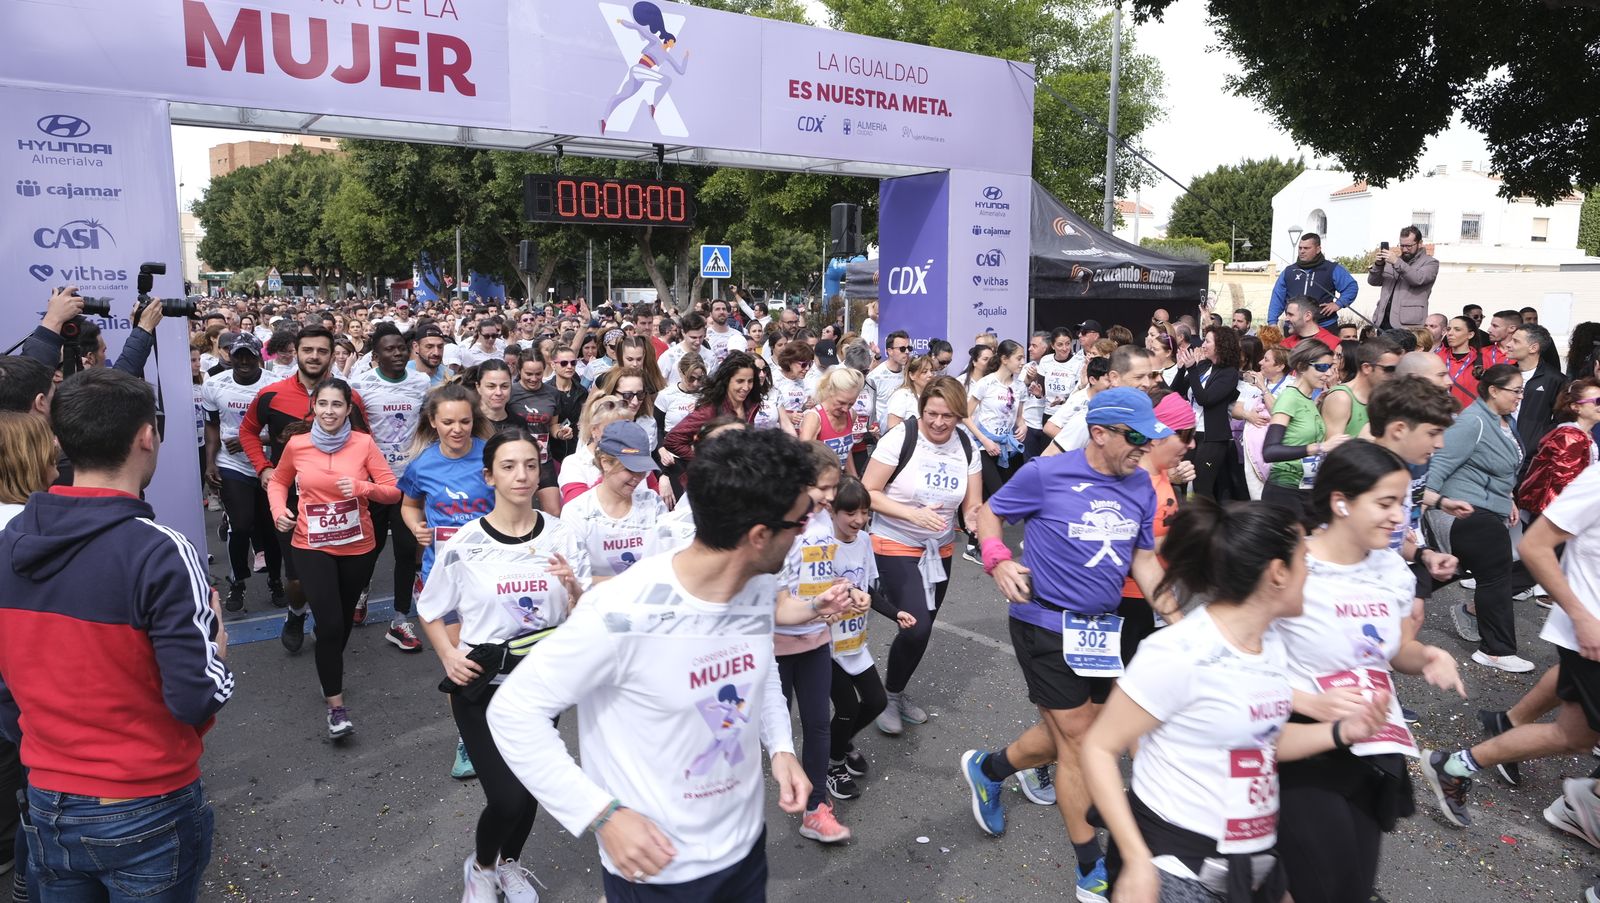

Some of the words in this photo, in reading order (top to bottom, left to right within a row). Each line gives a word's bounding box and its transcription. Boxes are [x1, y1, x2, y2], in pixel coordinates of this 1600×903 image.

[183, 0, 476, 96] MUJER
[818, 51, 839, 72] LA
[844, 55, 929, 85] IGUALDAD
[789, 79, 812, 100] ES
[817, 82, 899, 111] NUESTRA
[902, 94, 952, 117] META.
[798, 115, 826, 133] CDX
[18, 139, 112, 155] HYUNDAI
[32, 154, 103, 167] Almerialva
[46, 183, 122, 199] cajamar
[975, 201, 1010, 210] HYUNDAI
[34, 227, 100, 250] CASI
[983, 226, 1012, 237] cajamar
[60, 265, 127, 281] vithas
[888, 260, 933, 295] CDX
[98, 283, 129, 291] cuidarte
[983, 276, 1009, 286] vithas
[977, 305, 1008, 318] aqualia
[1048, 383, 1066, 391] 1363
[227, 401, 251, 410] MUJE
[383, 403, 413, 412] MUJER
[924, 472, 960, 490] 1319
[319, 513, 349, 528] 644
[603, 536, 644, 551] MUJER
[809, 561, 833, 577] 183
[496, 580, 549, 595] MUJER
[1334, 603, 1391, 618] MUJER
[1078, 630, 1107, 649] 302
[689, 653, 757, 690] MUJER
